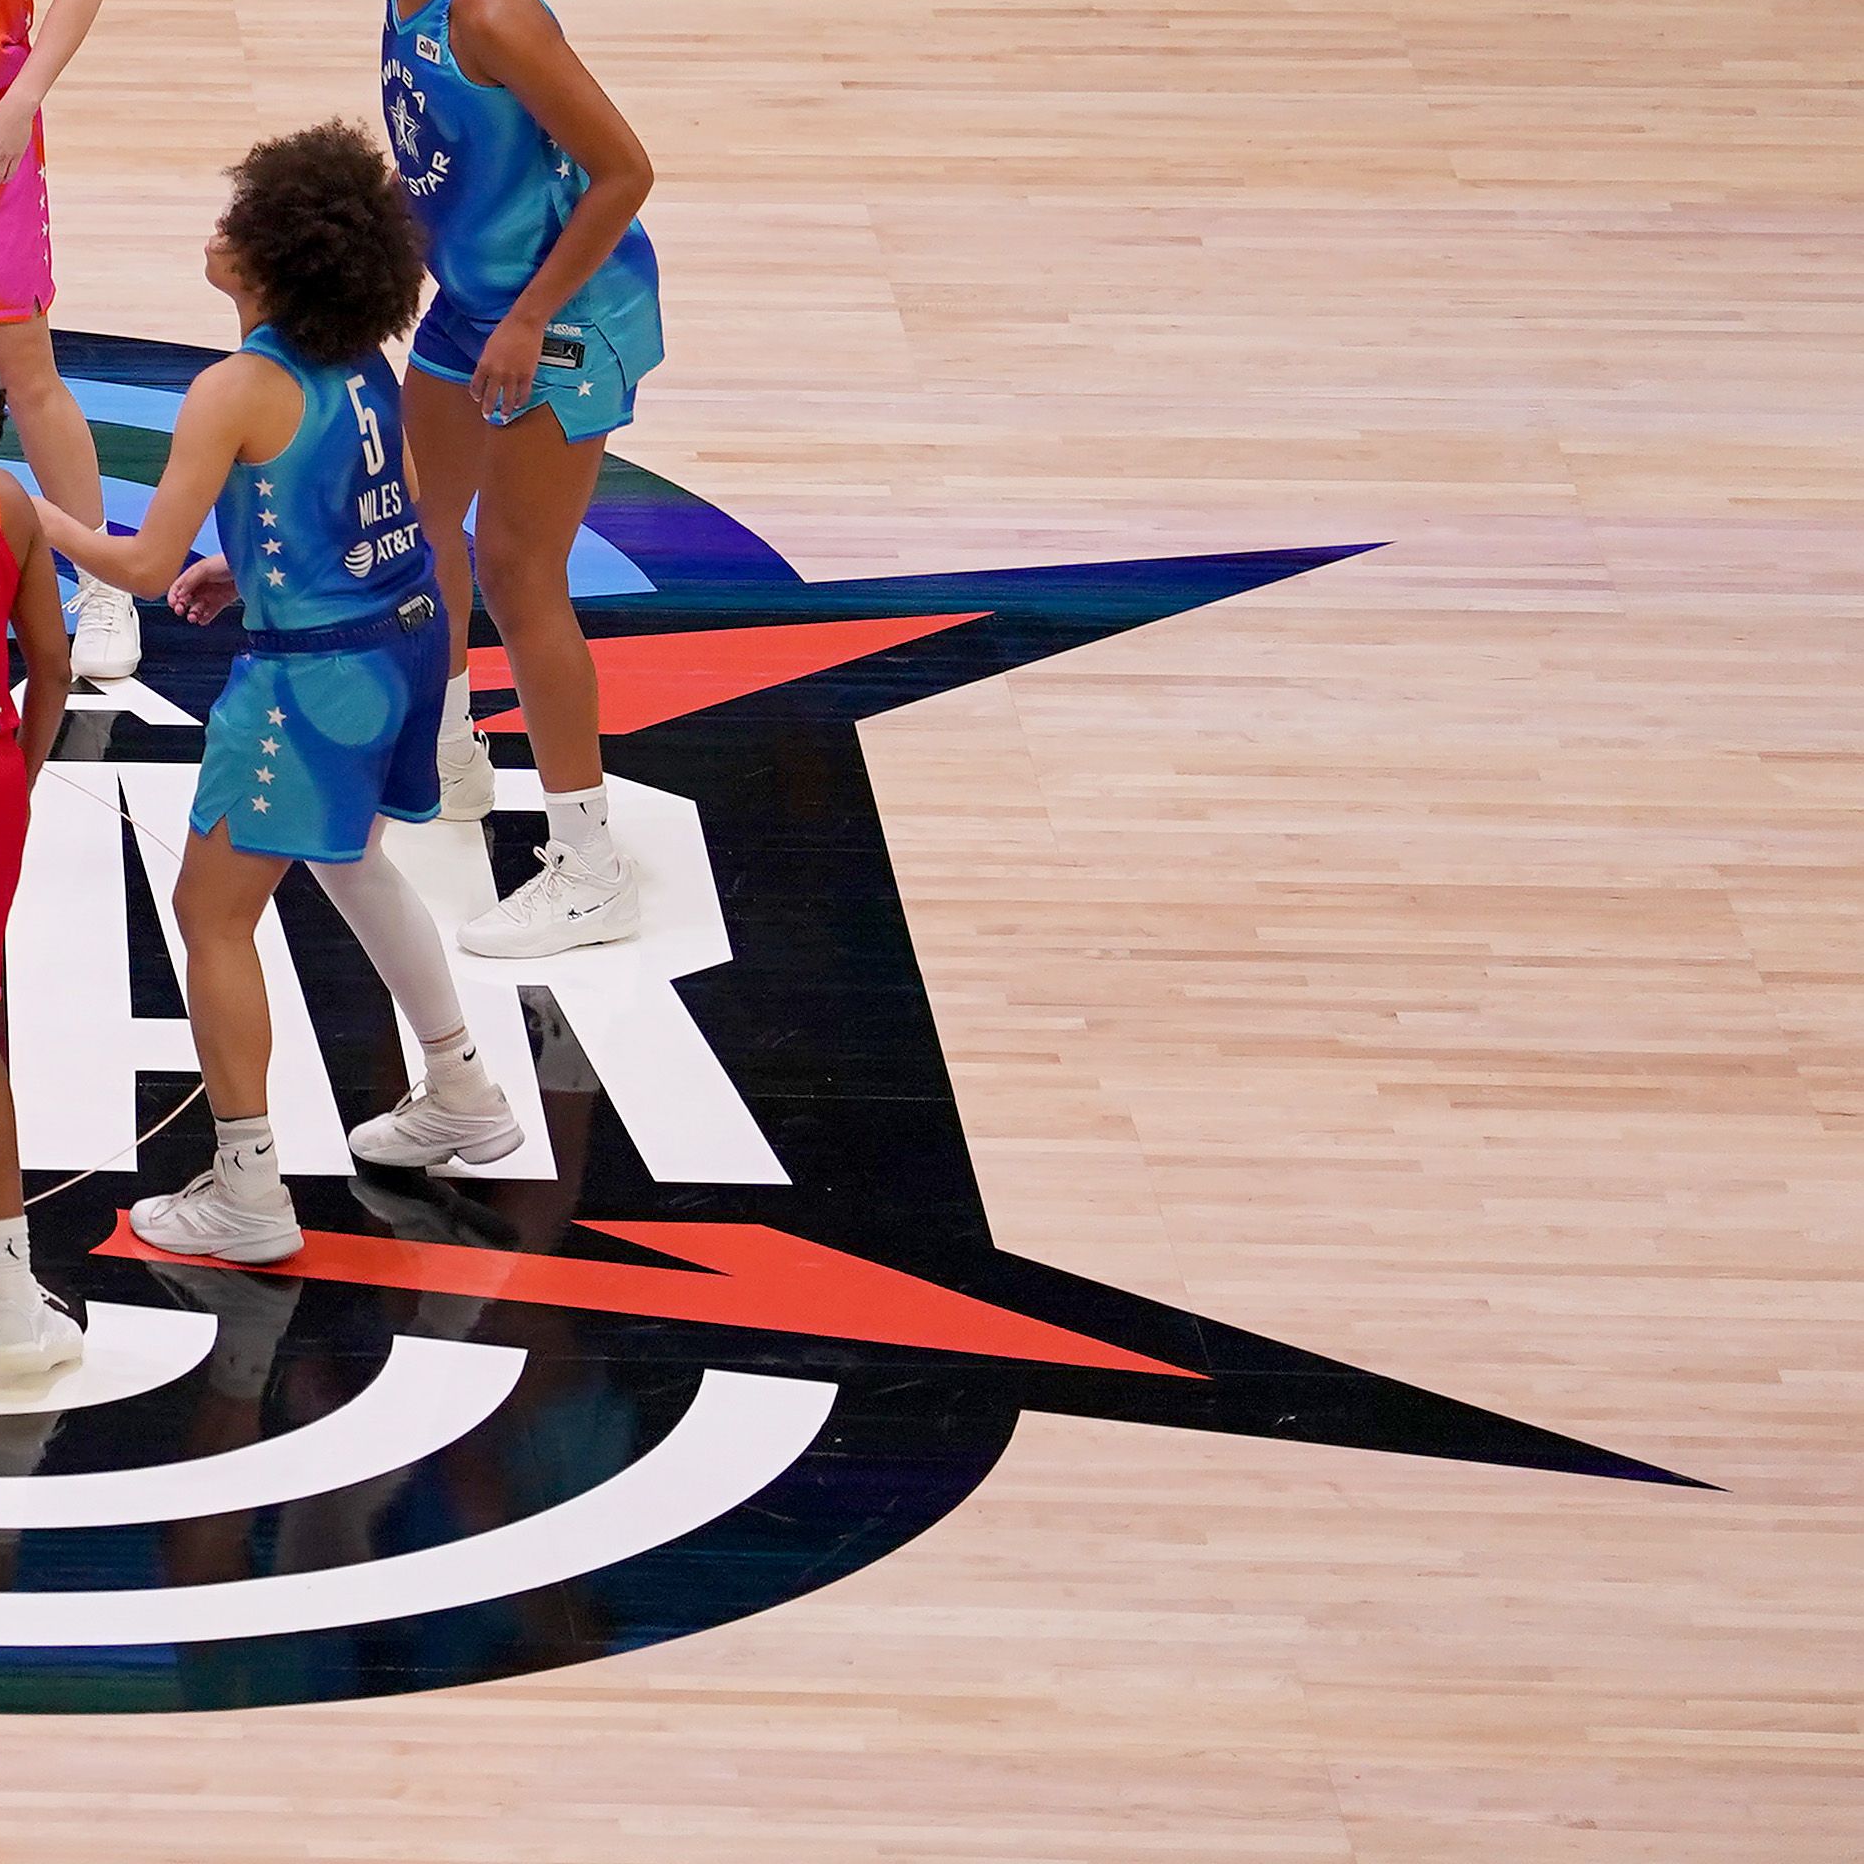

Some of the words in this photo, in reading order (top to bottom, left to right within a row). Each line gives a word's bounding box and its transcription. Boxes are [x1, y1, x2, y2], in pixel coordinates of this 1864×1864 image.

[417, 38, 439, 62] ally
[382, 58, 427, 114] WNBA
[345, 373, 386, 477] 5
[357, 480, 404, 530] MILES
[375, 522, 420, 565] AT&T
